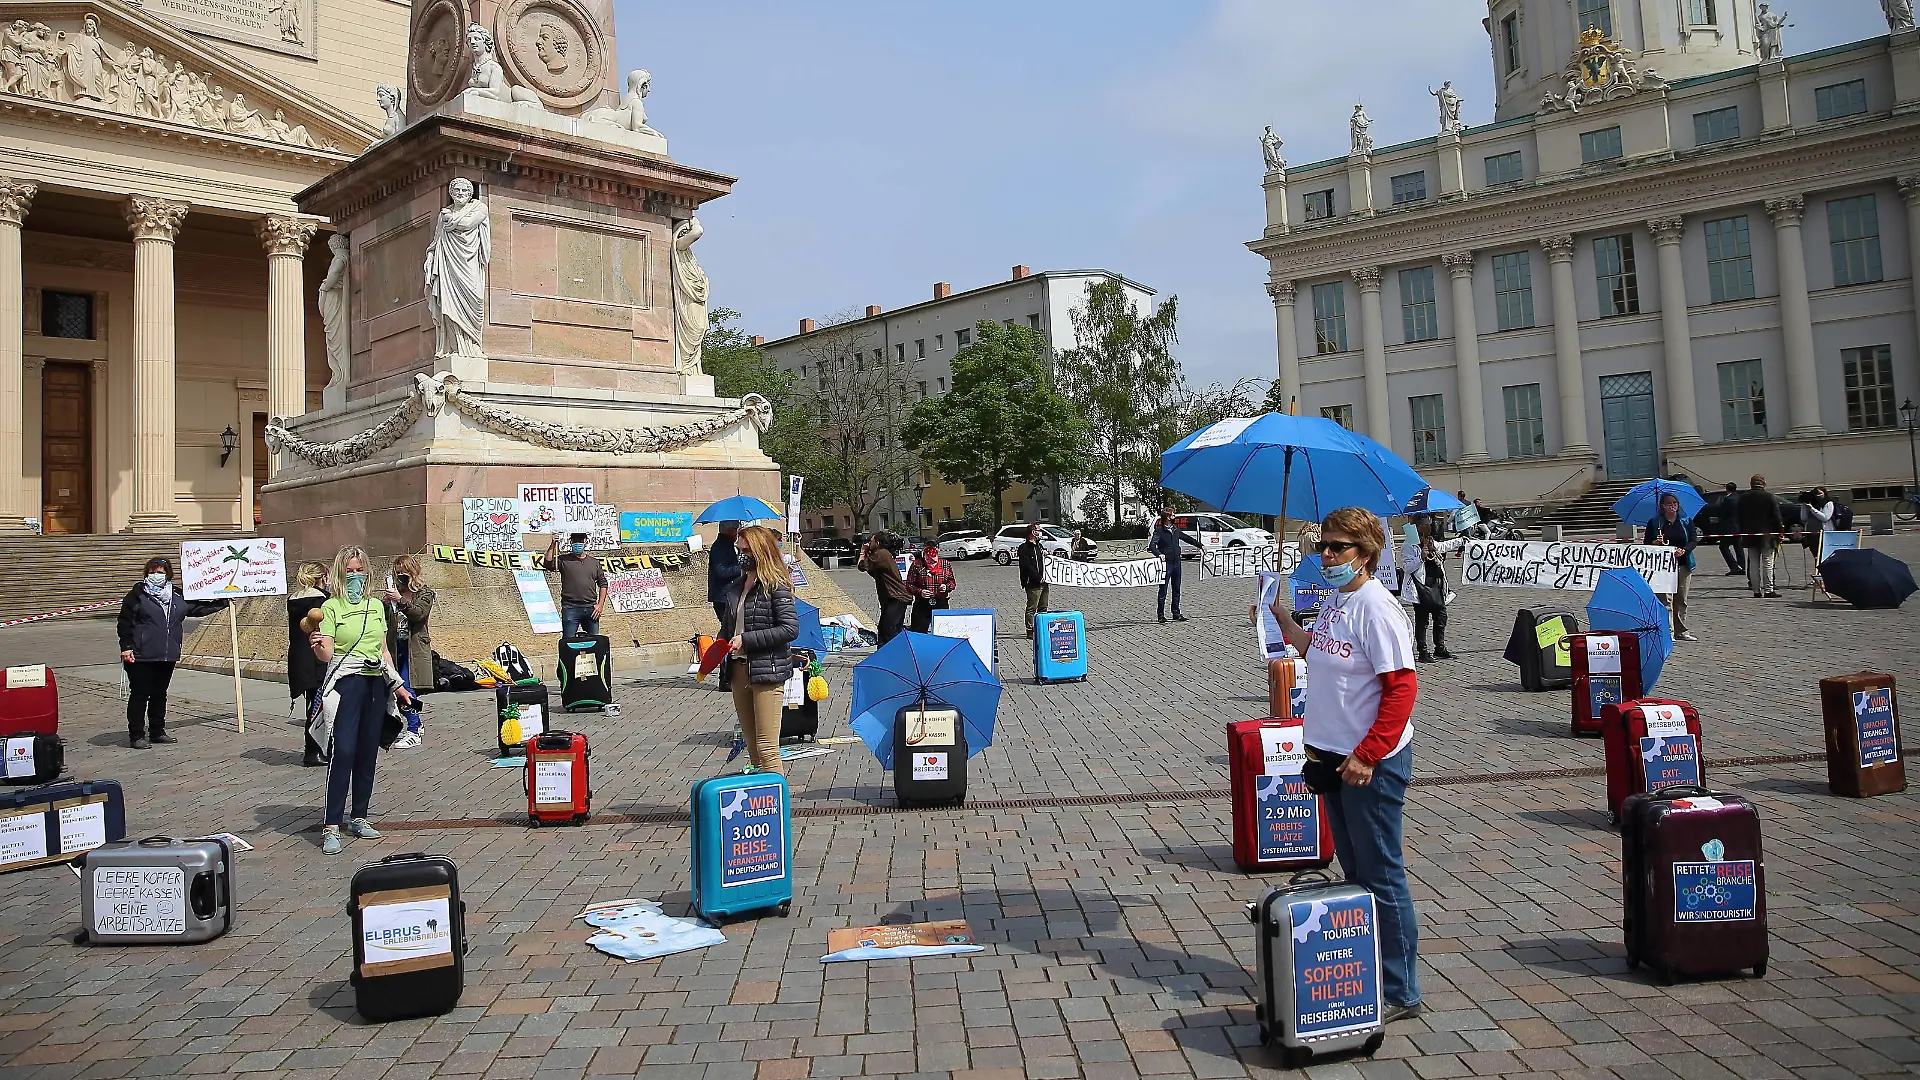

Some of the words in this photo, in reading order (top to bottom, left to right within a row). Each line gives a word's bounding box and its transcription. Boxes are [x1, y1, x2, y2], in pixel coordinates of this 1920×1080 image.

[200, 9, 223, 20] GOTT
[225, 14, 262, 29] SCHAUEN
[523, 487, 559, 502] RETTET
[564, 487, 592, 504] REISE
[464, 499, 485, 511] WIR
[487, 499, 513, 512] SIND
[509, 514, 519, 524] DE
[634, 517, 675, 527] SONNEN
[654, 527, 681, 537] PLATZ
[1201, 547, 1252, 579] RETTET
[1043, 556, 1077, 583] RETTET
[1080, 560, 1167, 586] REISEBRANCHE
[1871, 696, 1886, 707] WIR
[1655, 710, 1663, 720] I
[13, 748, 18, 756] I
[1275, 742, 1281, 754] I
[1666, 743, 1689, 755] WIR
[922, 756, 928, 766] I
[1662, 753, 1694, 762] TOURISTIK
[1661, 768, 1682, 779] EXIT-
[749, 795, 774, 809] WIR
[1278, 792, 1314, 802] TOURISTIK
[743, 806, 778, 818] TOURISTIK
[1265, 807, 1285, 819] 2.9
[1287, 805, 1311, 818] Mio
[732, 822, 770, 841] 3.000
[1269, 821, 1306, 832] ARBEITS-
[1272, 831, 1303, 842] PLÄTZE
[733, 839, 772, 857] REISE-
[1262, 845, 1314, 855] SYSTEMRELEVANT
[728, 853, 778, 867] VERANSTALTER
[727, 868, 735, 876] IN
[735, 861, 779, 874] DEUTSCHLAND
[1676, 864, 1710, 875] RETTET
[1716, 863, 1751, 877] REISE
[97, 871, 140, 884] LEERE
[143, 871, 181, 885] KOFFER
[1716, 875, 1752, 885] BRANCHE
[96, 886, 135, 899] LEERE
[139, 887, 182, 899] KASSEN
[113, 901, 148, 915] KEINE
[97, 915, 184, 932] ARBEITSPLÄTZE
[1330, 908, 1365, 928] WIR
[365, 925, 421, 941] ELBRUS
[383, 930, 449, 945] ERLEBNISREISEN
[1322, 924, 1371, 941] TOURISTIK
[1316, 948, 1353, 962] WEITERE
[1304, 961, 1368, 985] SOFORT-
[1311, 979, 1363, 1002] HILFEN
[1300, 1003, 1374, 1026] REISEBRANCHE
